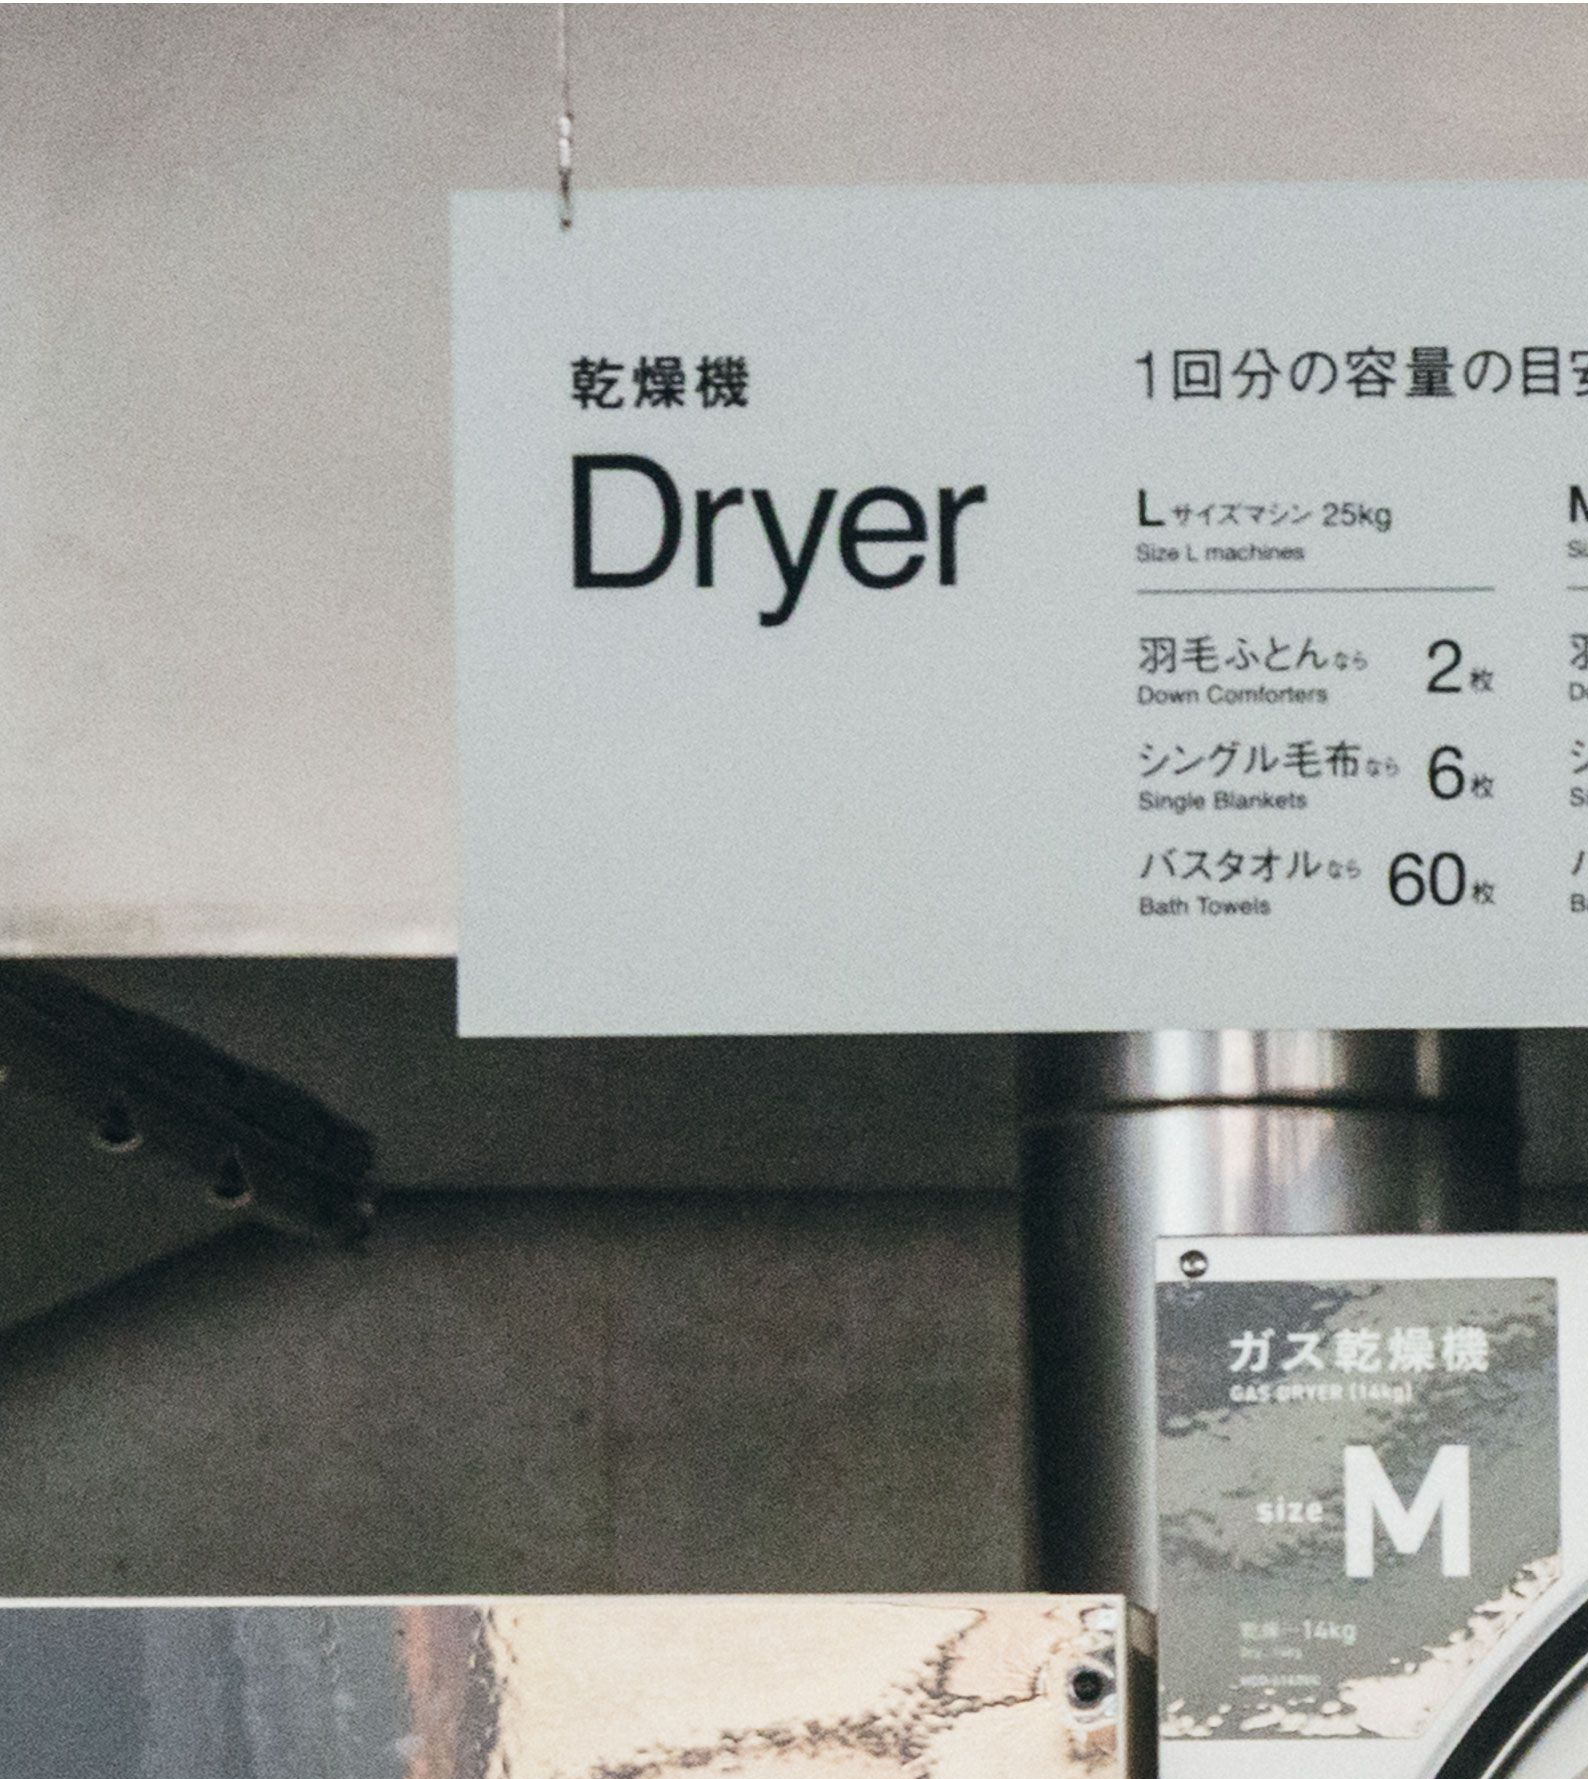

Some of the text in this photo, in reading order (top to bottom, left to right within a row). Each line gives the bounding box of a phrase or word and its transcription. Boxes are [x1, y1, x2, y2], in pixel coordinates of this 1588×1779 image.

[571, 356, 749, 409] 乾燥機
[1323, 502, 1392, 533] 25kg
[572, 454, 987, 627] Dryer
[1136, 543, 1305, 562] Size L machines
[1137, 684, 1328, 705] Down Comforters
[1139, 790, 1307, 814] Single Blankets
[1139, 896, 1271, 916] Bath Towels
[1231, 1326, 1488, 1374] ガス乾燥機
[1255, 1496, 1324, 1524] size
[1343, 1445, 1471, 1577] M
